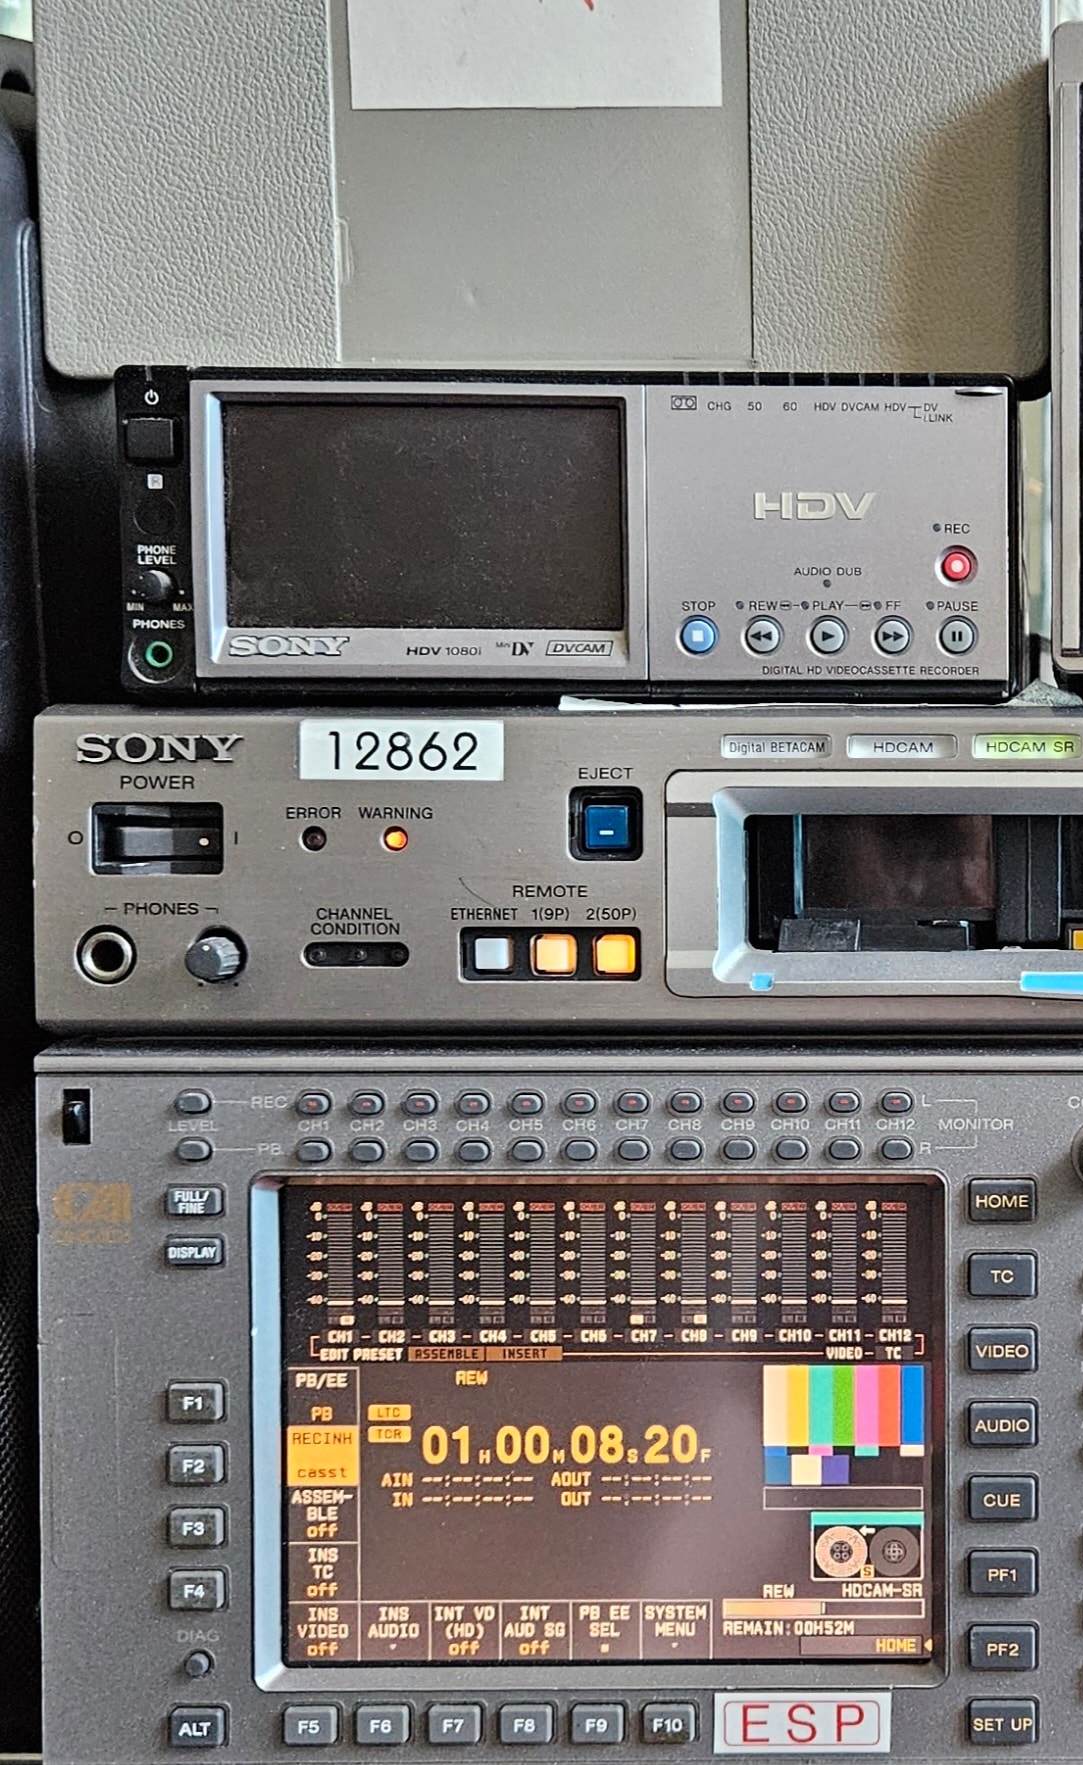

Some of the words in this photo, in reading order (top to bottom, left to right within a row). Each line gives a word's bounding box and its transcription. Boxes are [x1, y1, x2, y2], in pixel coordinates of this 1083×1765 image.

[707, 401, 732, 411] CHG
[747, 401, 762, 411] 50
[782, 401, 798, 411] 60
[814, 401, 836, 411] HDV
[842, 401, 879, 411] DVCAM
[884, 401, 907, 411] HDV
[754, 491, 876, 520] HDV
[944, 523, 970, 534] REC
[137, 545, 176, 555] PHONE
[137, 556, 177, 565] LEVEL
[794, 567, 832, 576] AUDIO
[836, 567, 862, 576] DUB
[682, 600, 716, 611] STOP
[749, 601, 778, 611] REW
[812, 600, 844, 611] PLAY
[937, 600, 978, 611] PAUSE
[133, 620, 185, 629] PHONES
[229, 635, 349, 656] SONY
[406, 647, 441, 655] HDV
[445, 647, 482, 655] 1080i
[550, 642, 610, 655] DVCAM
[762, 665, 803, 675] DIGITAL
[807, 665, 822, 675] HD
[826, 665, 915, 675] VIDEOCASSETTE
[920, 665, 979, 676] RECORDER
[75, 732, 243, 764] SONY
[328, 731, 479, 771] 12862
[729, 741, 766, 754] Digital
[771, 741, 825, 753] BETACAM
[873, 742, 933, 753] HDCAM
[986, 741, 1046, 753] HDCAM
[1054, 741, 1074, 753] SR
[578, 767, 633, 780] EJECT
[120, 776, 195, 790] POWER
[286, 807, 342, 820] ERROR
[359, 807, 434, 820] WARNING
[513, 885, 588, 898] REMOTE
[124, 902, 199, 916] PHONES
[316, 908, 393, 921] CHANNEL
[450, 908, 518, 921] ETHERNET
[531, 908, 570, 923] 1(9P)
[586, 908, 636, 923] 2(50P)
[310, 922, 400, 936] CONDITION
[938, 1118, 1014, 1131] MONITOR
[975, 1194, 1029, 1209] HOME
[168, 1247, 216, 1259] DISPLAY
[991, 1270, 1014, 1284] TC
[976, 1344, 1029, 1358] VIDEO
[975, 1419, 1030, 1433] AUDIO
[292, 1432, 353, 1446] RECINH
[983, 1494, 1020, 1508] CUE
[988, 1568, 1017, 1582] PF1
[842, 1584, 923, 1597] HDCAM-SR
[644, 1605, 707, 1619] SYSTEM
[654, 1623, 695, 1636] MENU
[876, 1639, 917, 1652] HOME
[986, 1643, 1019, 1656] PF2
[179, 1722, 212, 1737] ALT
